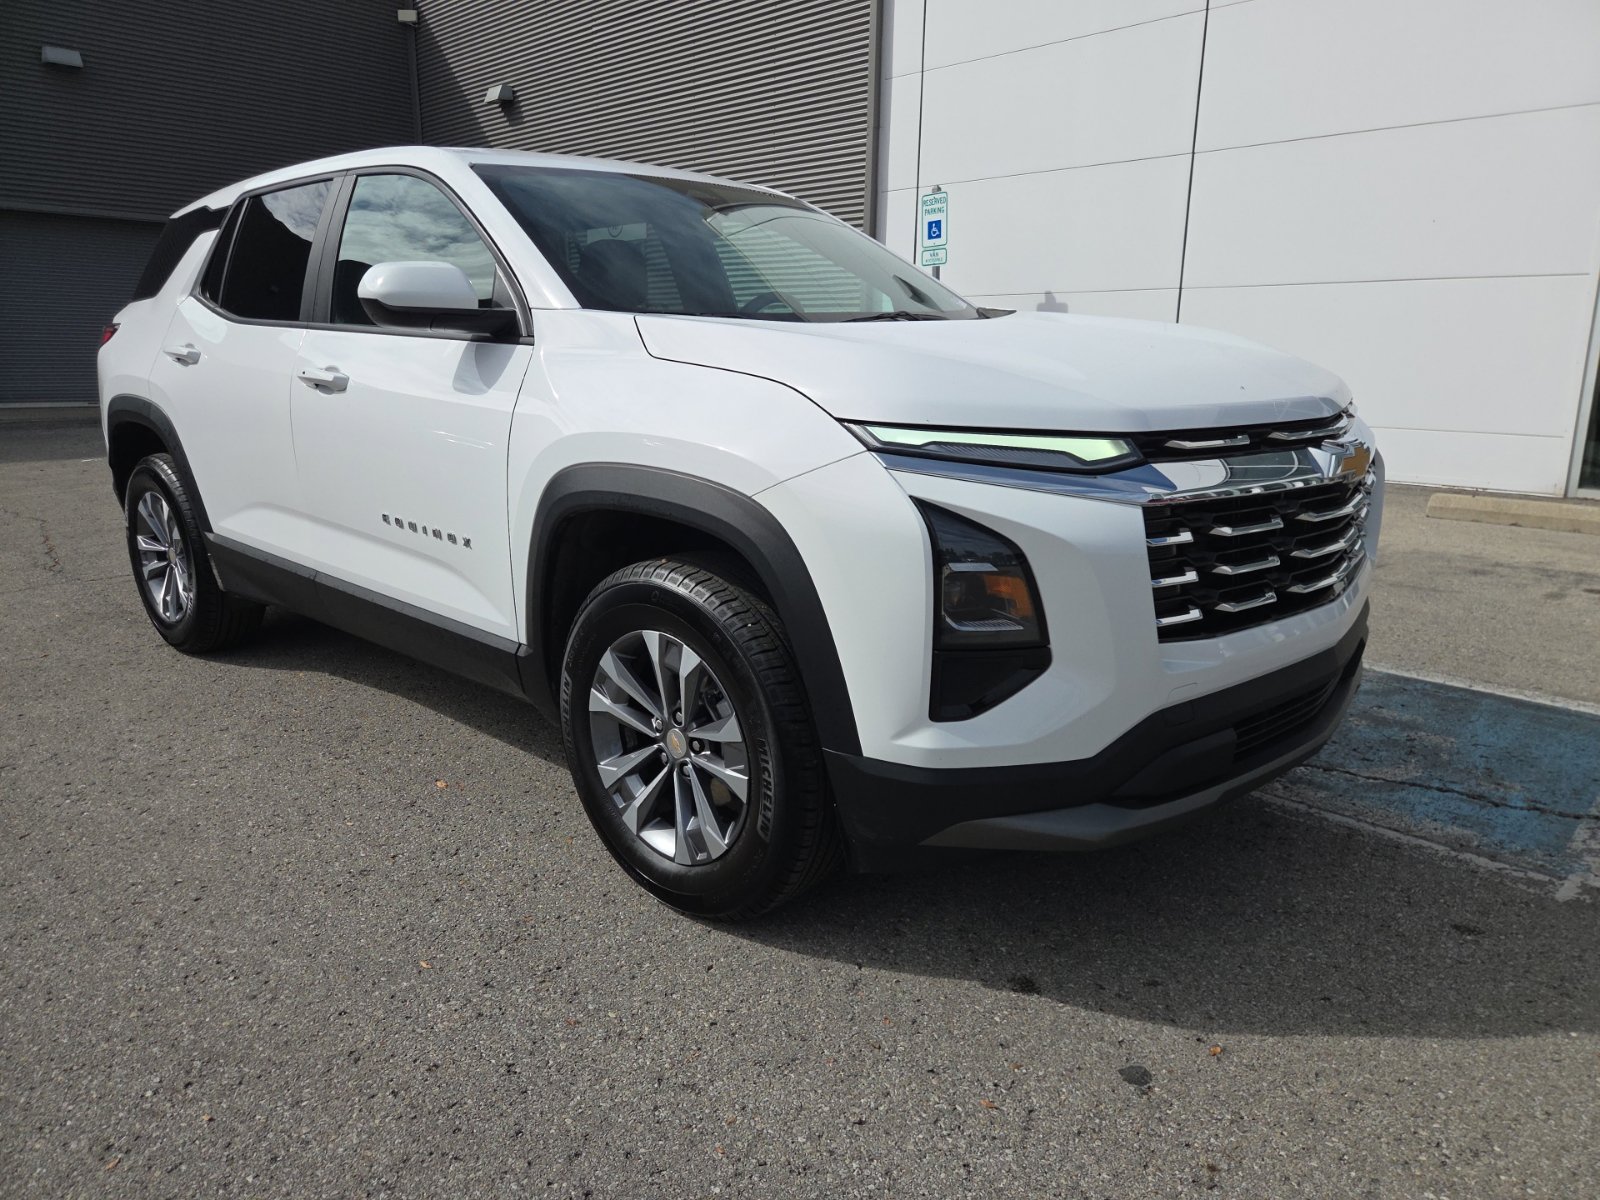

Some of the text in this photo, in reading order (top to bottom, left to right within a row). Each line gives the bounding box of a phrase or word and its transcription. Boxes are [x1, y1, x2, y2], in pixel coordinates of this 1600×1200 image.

[923, 196, 946, 207] RESERVED
[924, 206, 945, 216] PARKING
[381, 513, 472, 550] EQUINOX
[757, 737, 772, 837] MICHELIN
